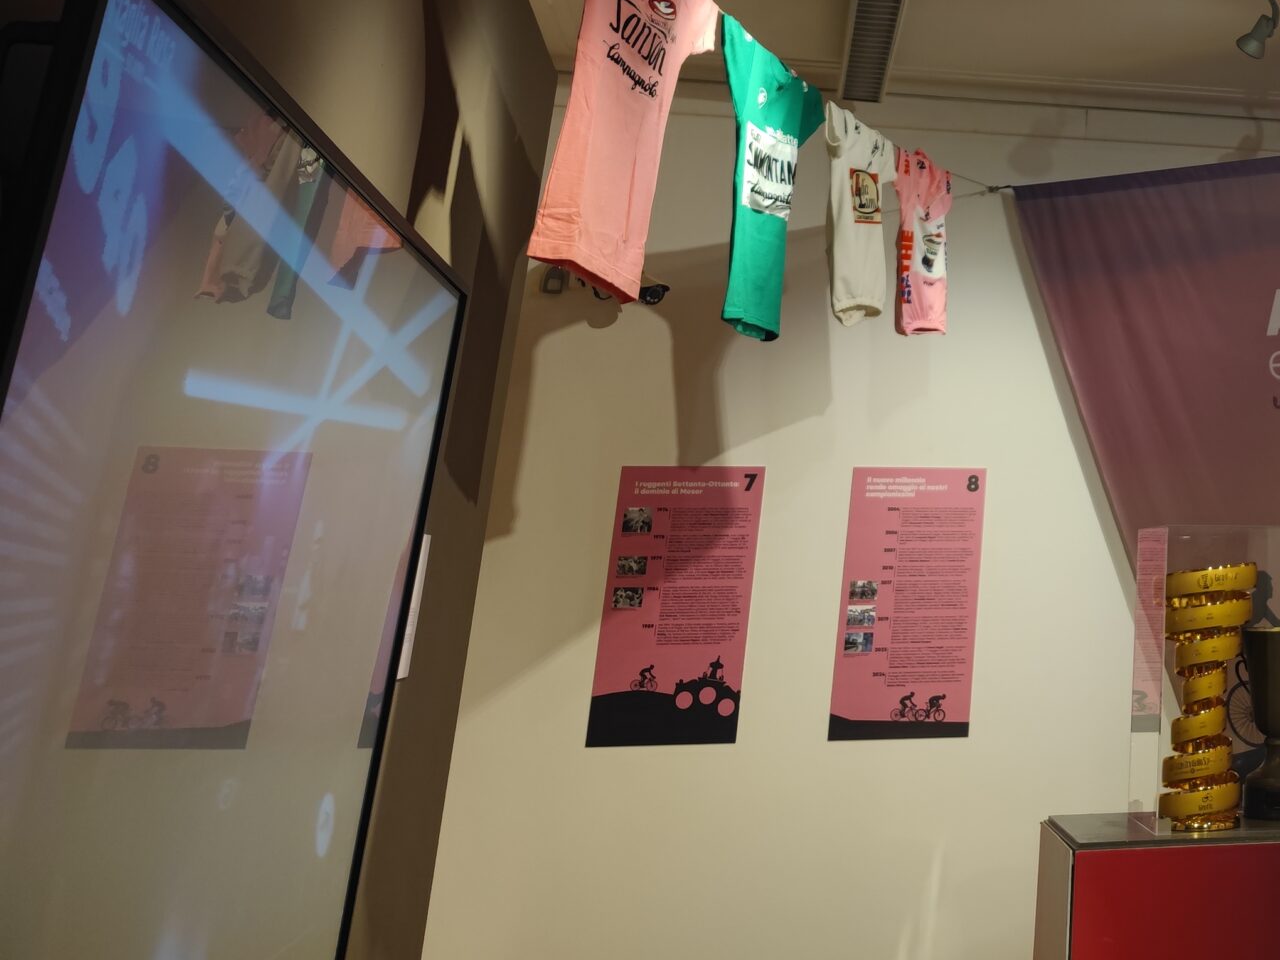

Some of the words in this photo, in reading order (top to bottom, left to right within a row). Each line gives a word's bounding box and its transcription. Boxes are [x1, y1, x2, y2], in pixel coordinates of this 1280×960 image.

[604, 41, 658, 98] Campagnolo
[743, 473, 758, 492] 7
[966, 474, 979, 492] 8
